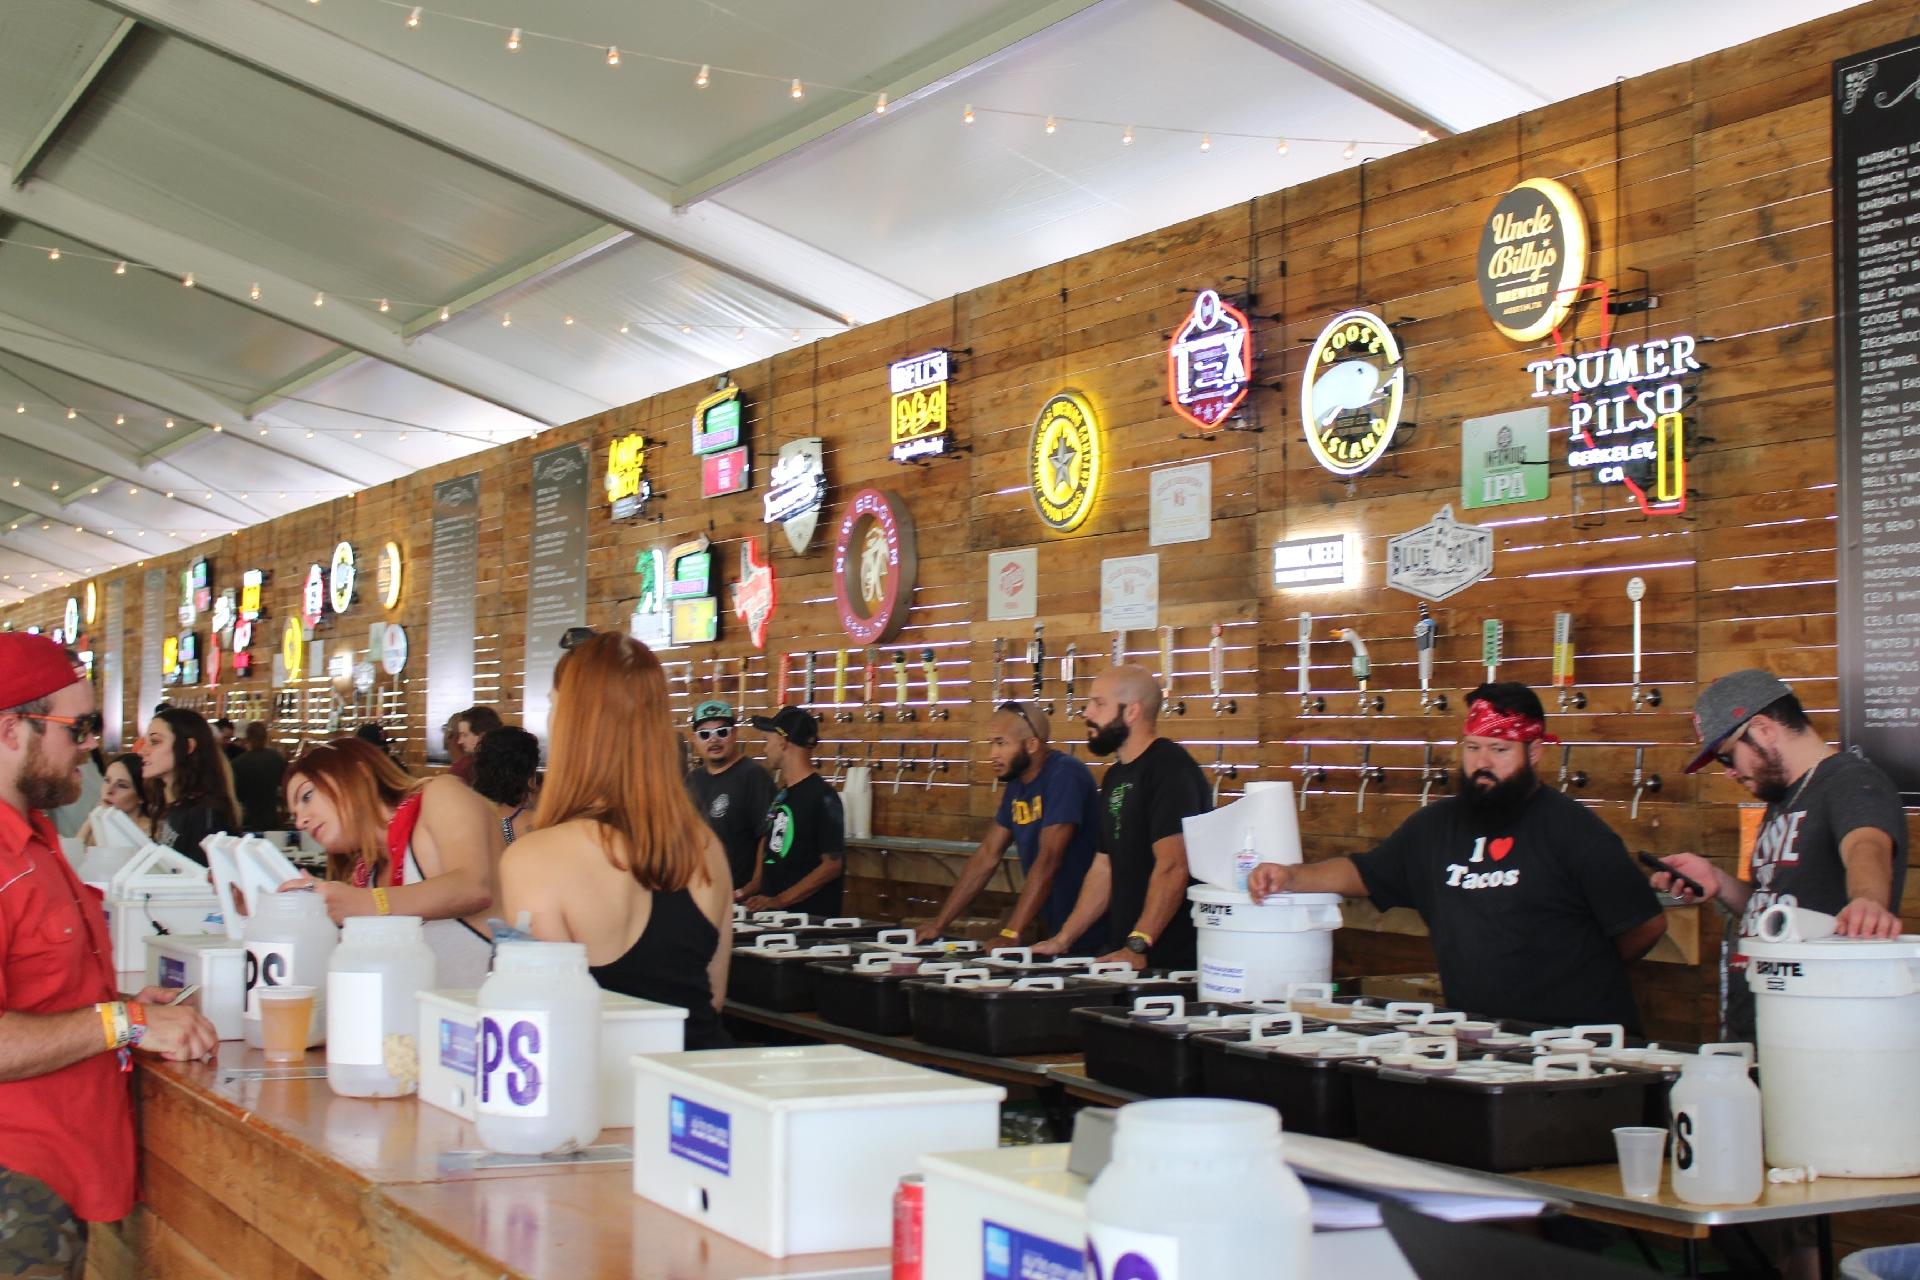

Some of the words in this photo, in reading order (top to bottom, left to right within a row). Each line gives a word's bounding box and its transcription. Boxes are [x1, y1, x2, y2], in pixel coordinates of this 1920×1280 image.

[1492, 204, 1553, 245] Uncle
[1321, 324, 1387, 363] GOOSE
[1527, 335, 1700, 398] TRUMER
[1320, 418, 1385, 460] ISLAND
[1482, 471, 1527, 503] IPA
[1598, 466, 1626, 482] CA
[1468, 836, 1487, 863] I
[1445, 863, 1520, 890] Tacos
[1756, 960, 1805, 977] BRUTE
